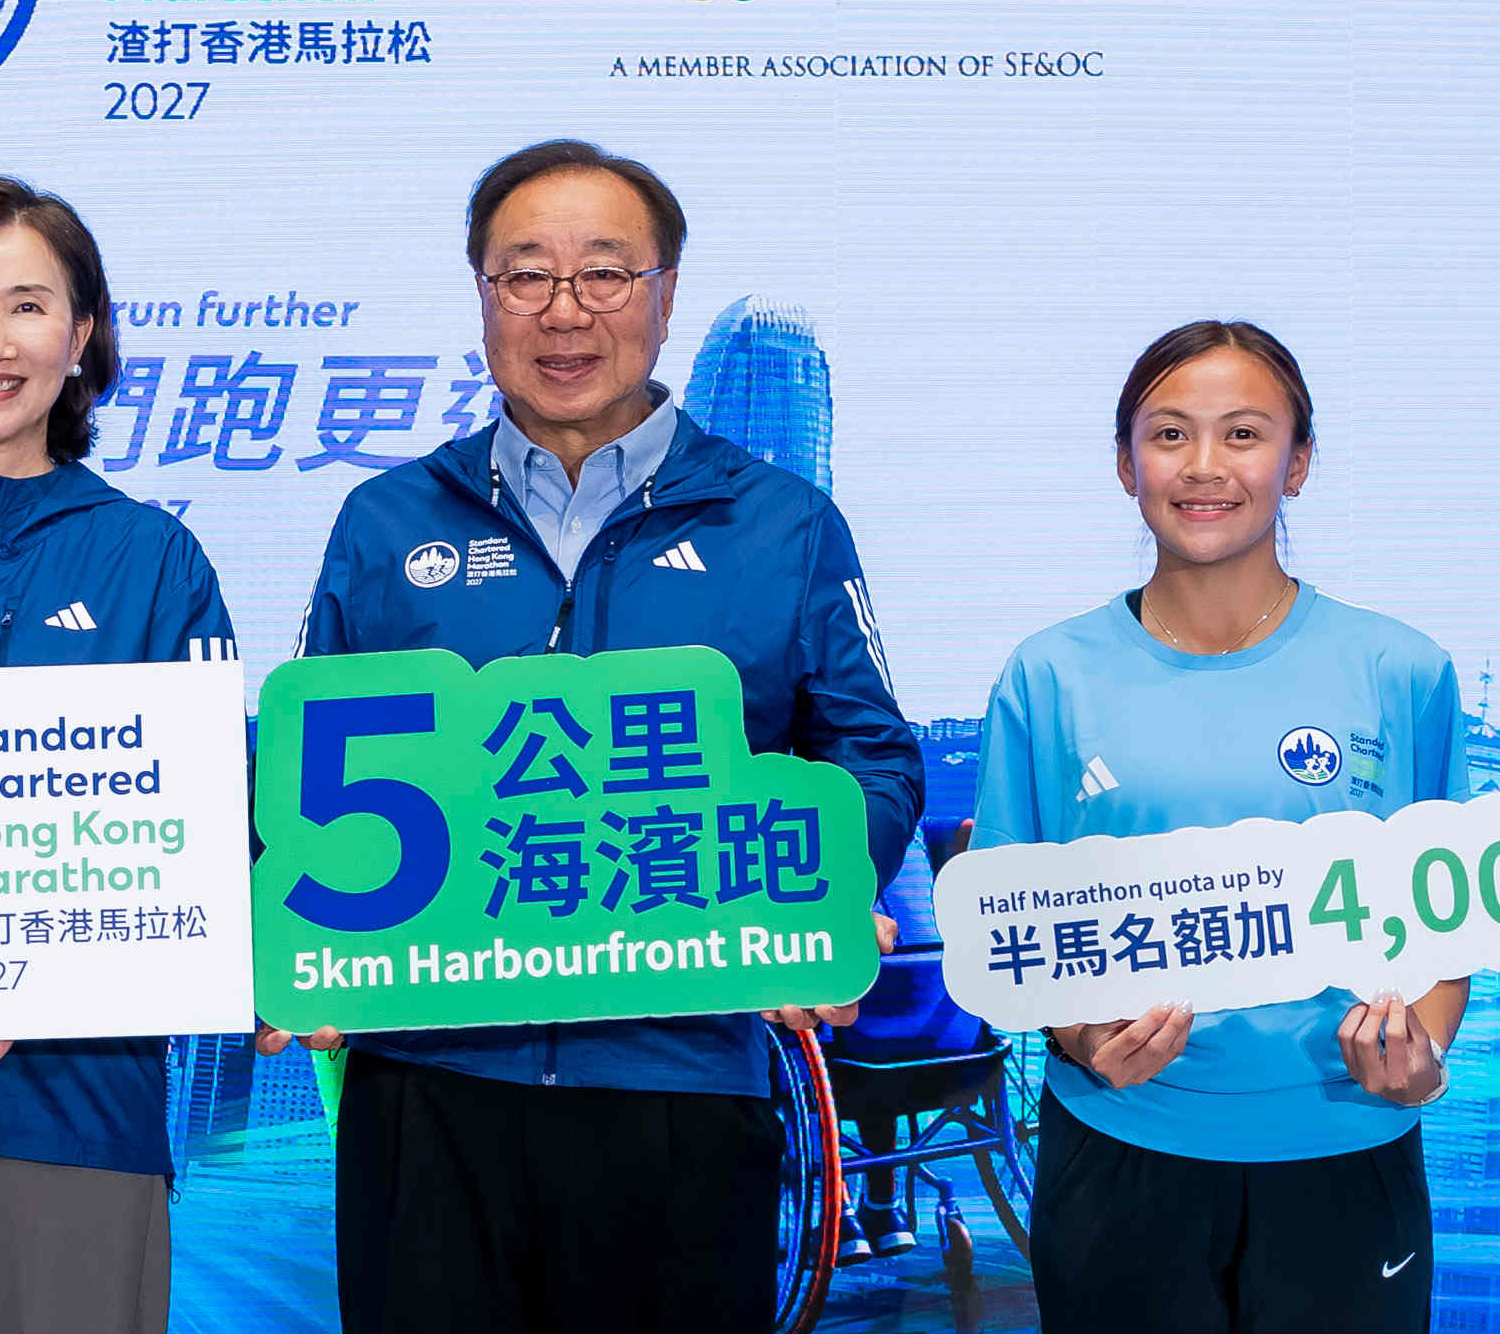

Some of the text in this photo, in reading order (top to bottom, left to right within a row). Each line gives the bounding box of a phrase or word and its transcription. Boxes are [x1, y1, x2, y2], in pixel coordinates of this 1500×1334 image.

[106, 18, 433, 66] 渣打香港馬拉松
[609, 51, 1105, 78] A MEMBER ASSOCIATION OF SF&OC
[104, 82, 211, 121] 2027
[197, 290, 361, 328] further
[481, 690, 710, 800] 公里
[73, 809, 187, 856] Kong
[283, 692, 451, 933] 5
[479, 798, 830, 920] 海濱跑
[979, 865, 1285, 917] Half Marathon quota up by
[293, 925, 834, 991] 5km Harbourfront Run
[987, 900, 1295, 986] 半馬名額加
